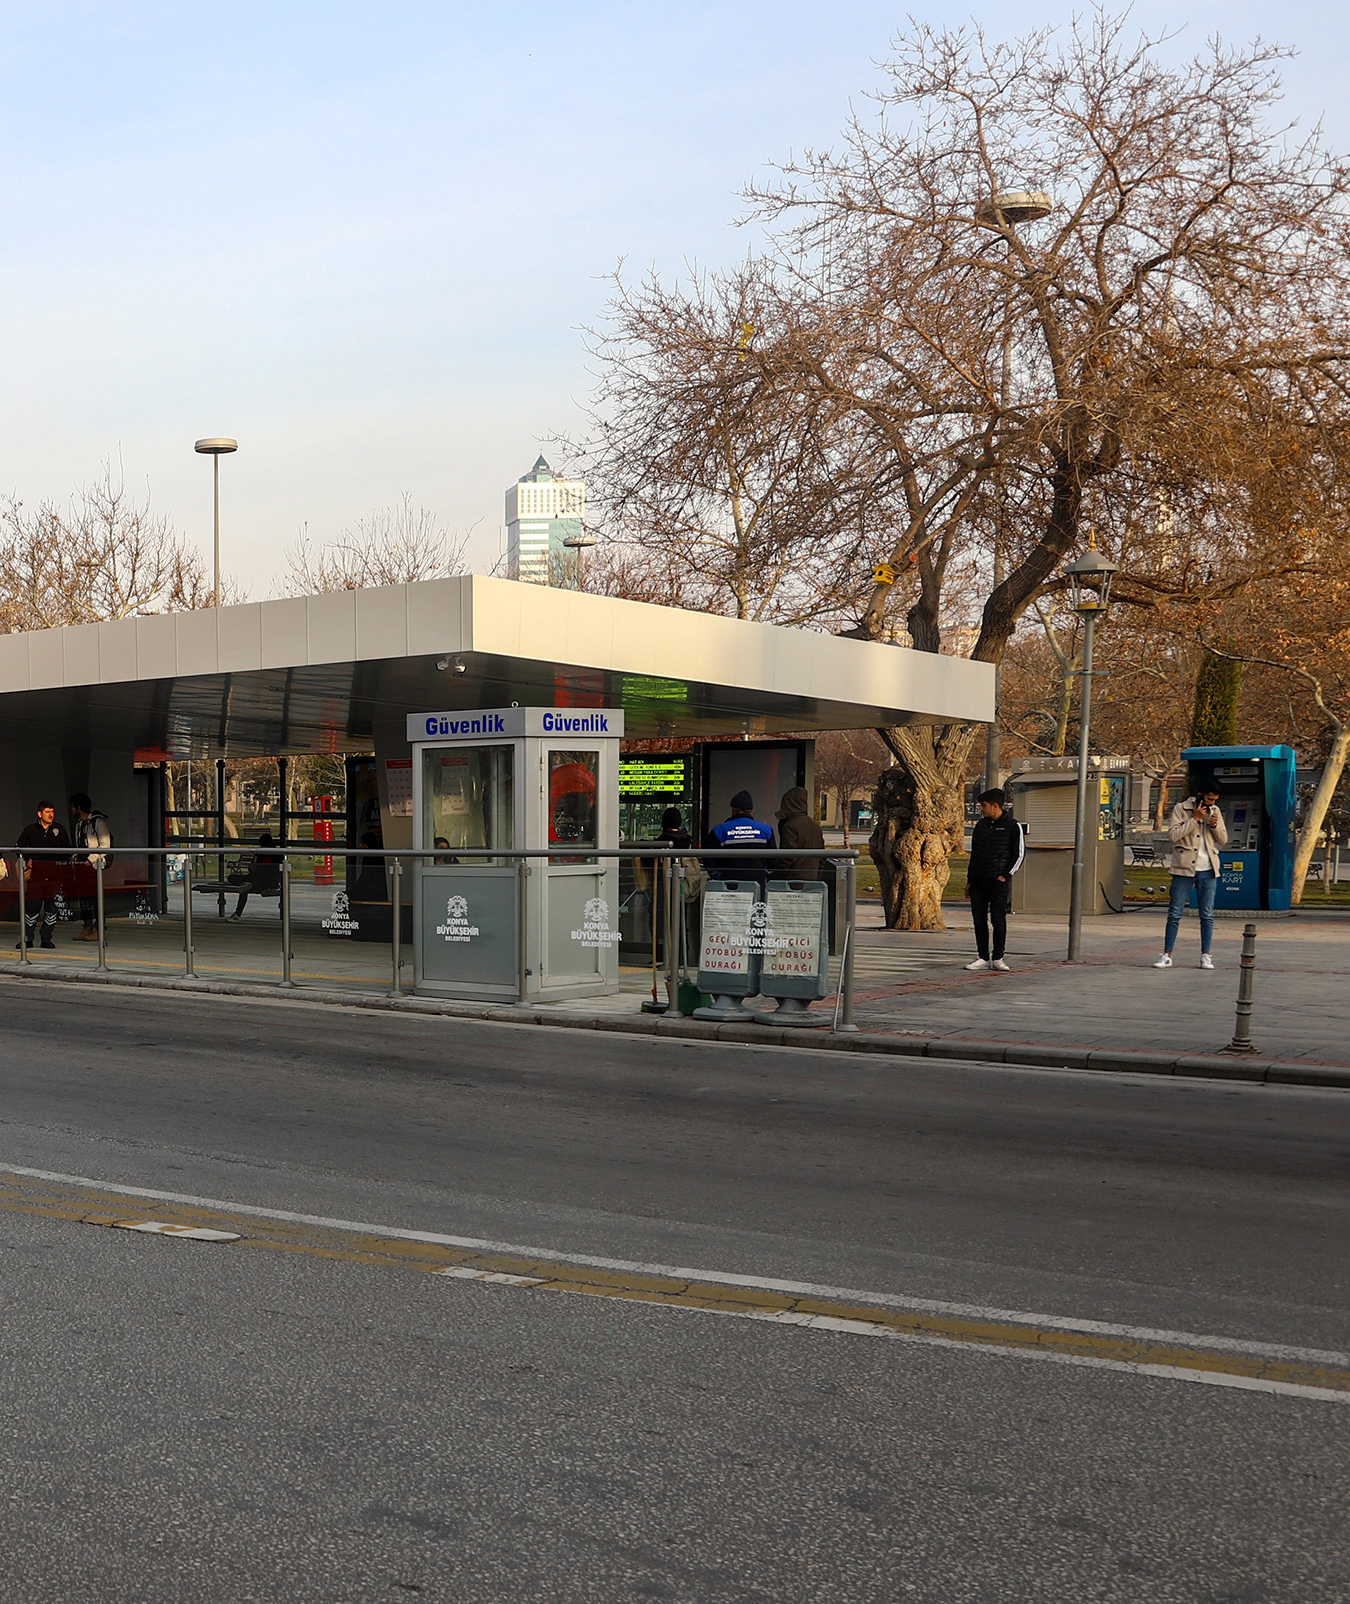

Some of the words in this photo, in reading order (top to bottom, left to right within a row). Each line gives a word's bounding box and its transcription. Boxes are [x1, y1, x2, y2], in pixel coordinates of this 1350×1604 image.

[425, 714, 505, 735] Güvenlik
[543, 713, 608, 732] Güvenlik
[321, 919, 359, 929] BÜYÜKŞEHİR
[583, 922, 609, 930] KONYA
[436, 925, 479, 936] BÜYÜKŞEHİR
[571, 929, 622, 941] BÜYÜKŞEHİR
[746, 928, 774, 936] KONYA
[709, 935, 730, 944] GEÇİ
[731, 936, 789, 948] BÜYÜKŞEHİR
[705, 947, 743, 957] OTOBÜS
[742, 947, 777, 955] BELEDİYESİ
[705, 960, 741, 970] DURAĞI
[771, 963, 812, 972] DURAĞI
